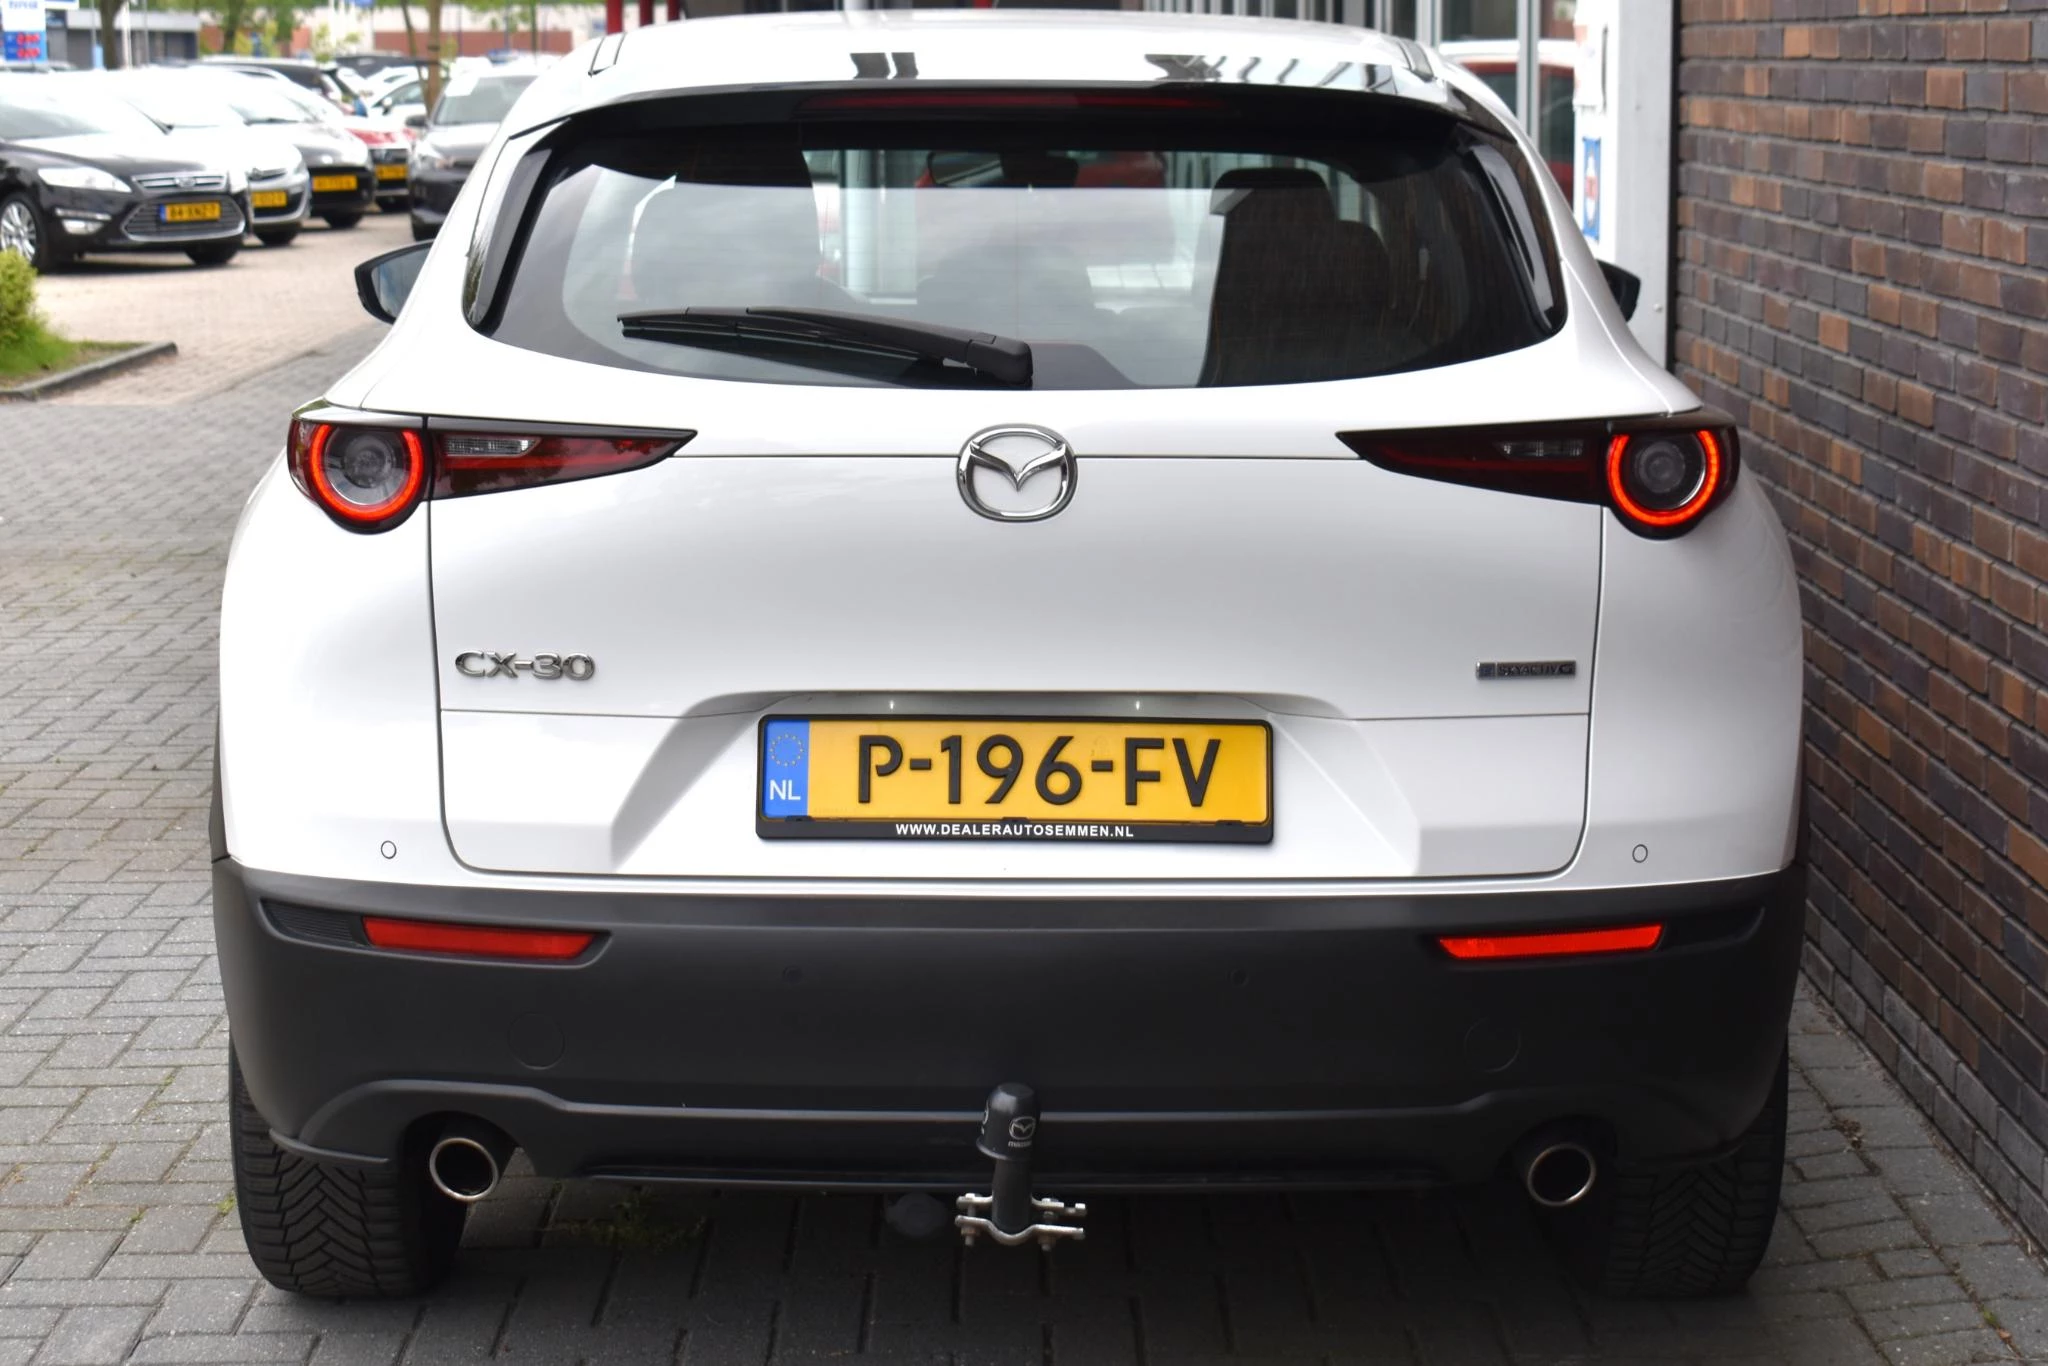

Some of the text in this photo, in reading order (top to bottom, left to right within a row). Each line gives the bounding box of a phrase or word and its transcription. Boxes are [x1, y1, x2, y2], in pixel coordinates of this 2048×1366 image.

[455, 650, 596, 681] CX-30
[858, 734, 1221, 807] P-196-FV
[769, 780, 801, 801] NL
[895, 823, 1134, 838] WWW.DEALERAUTOSEMMEN.NL
